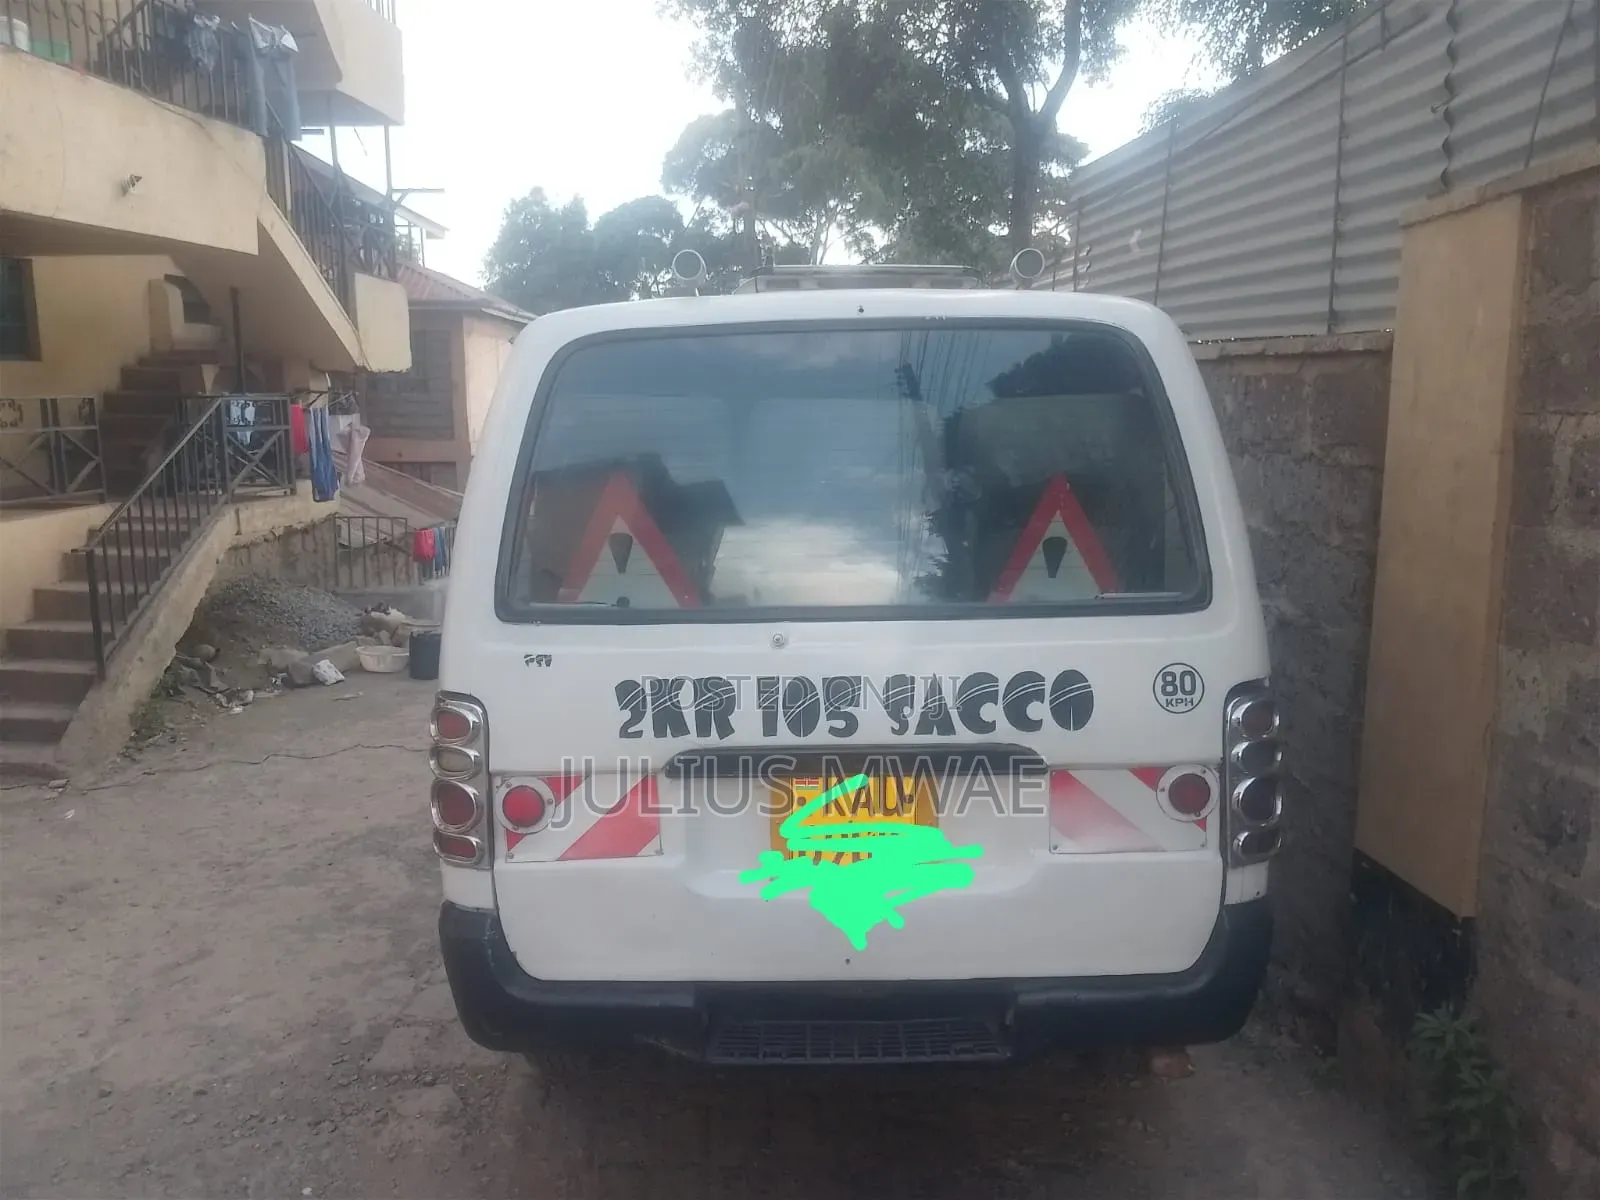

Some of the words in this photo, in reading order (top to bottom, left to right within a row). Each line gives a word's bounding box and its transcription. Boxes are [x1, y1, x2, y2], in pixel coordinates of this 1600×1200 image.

[1161, 670, 1197, 696] 80
[757, 675, 860, 738] 105
[883, 669, 1094, 736] SACCO
[1165, 697, 1194, 708] KPH
